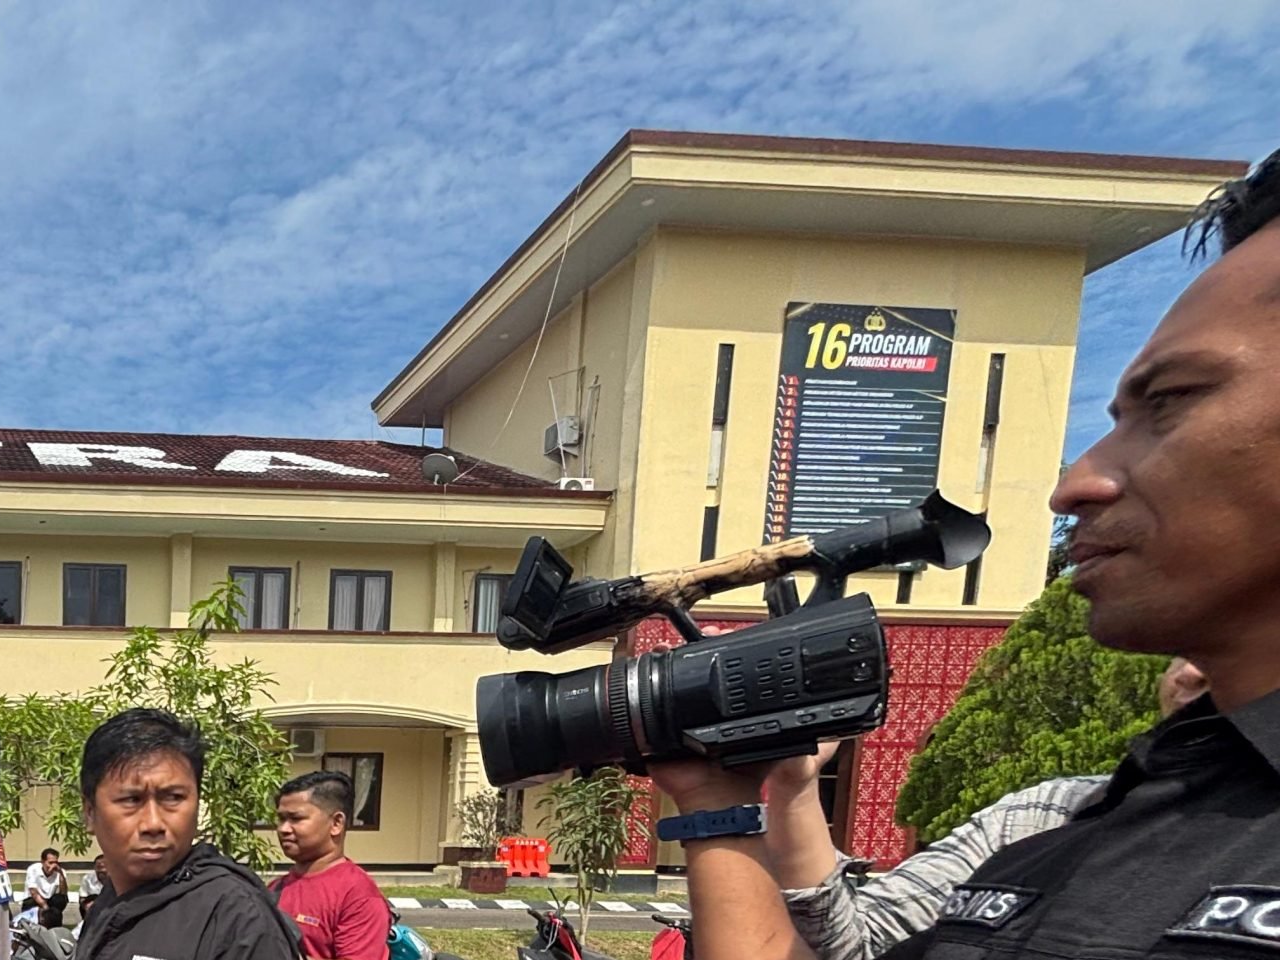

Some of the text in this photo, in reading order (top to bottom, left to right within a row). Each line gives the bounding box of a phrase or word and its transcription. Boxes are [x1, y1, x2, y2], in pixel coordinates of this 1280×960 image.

[805, 322, 851, 370] 16
[848, 333, 932, 355] PROGRAM
[845, 356, 927, 369] PRIORITAS KAPOLRI
